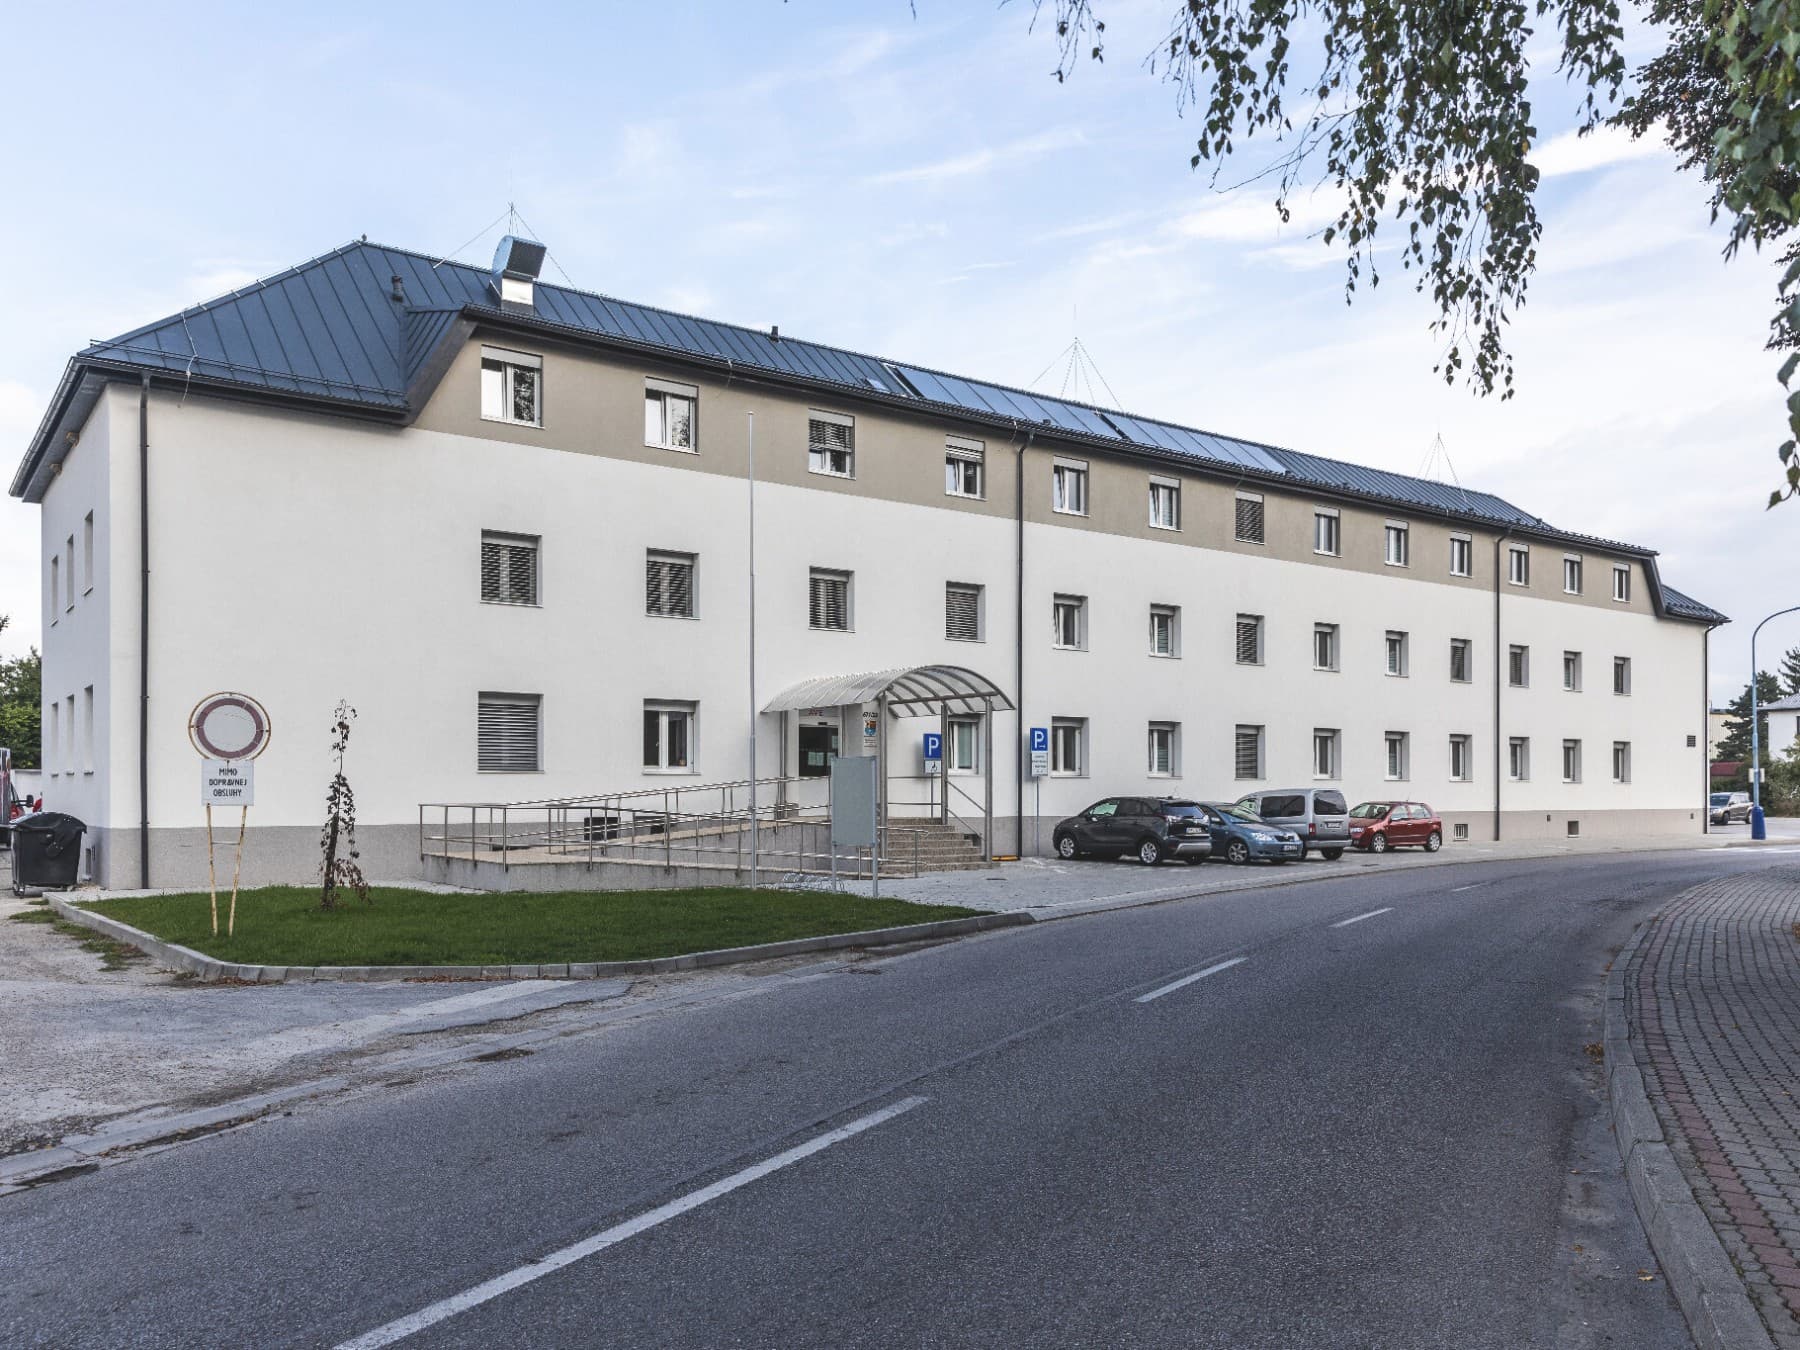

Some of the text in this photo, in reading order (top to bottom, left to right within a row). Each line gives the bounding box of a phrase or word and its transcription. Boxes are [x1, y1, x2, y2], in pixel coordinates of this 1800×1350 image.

[1034, 730, 1044, 749] P
[928, 736, 939, 756] P
[218, 768, 238, 776] MIMO
[209, 778, 247, 786] DOPRAVNEJ
[213, 788, 242, 797] OBSLUHY
